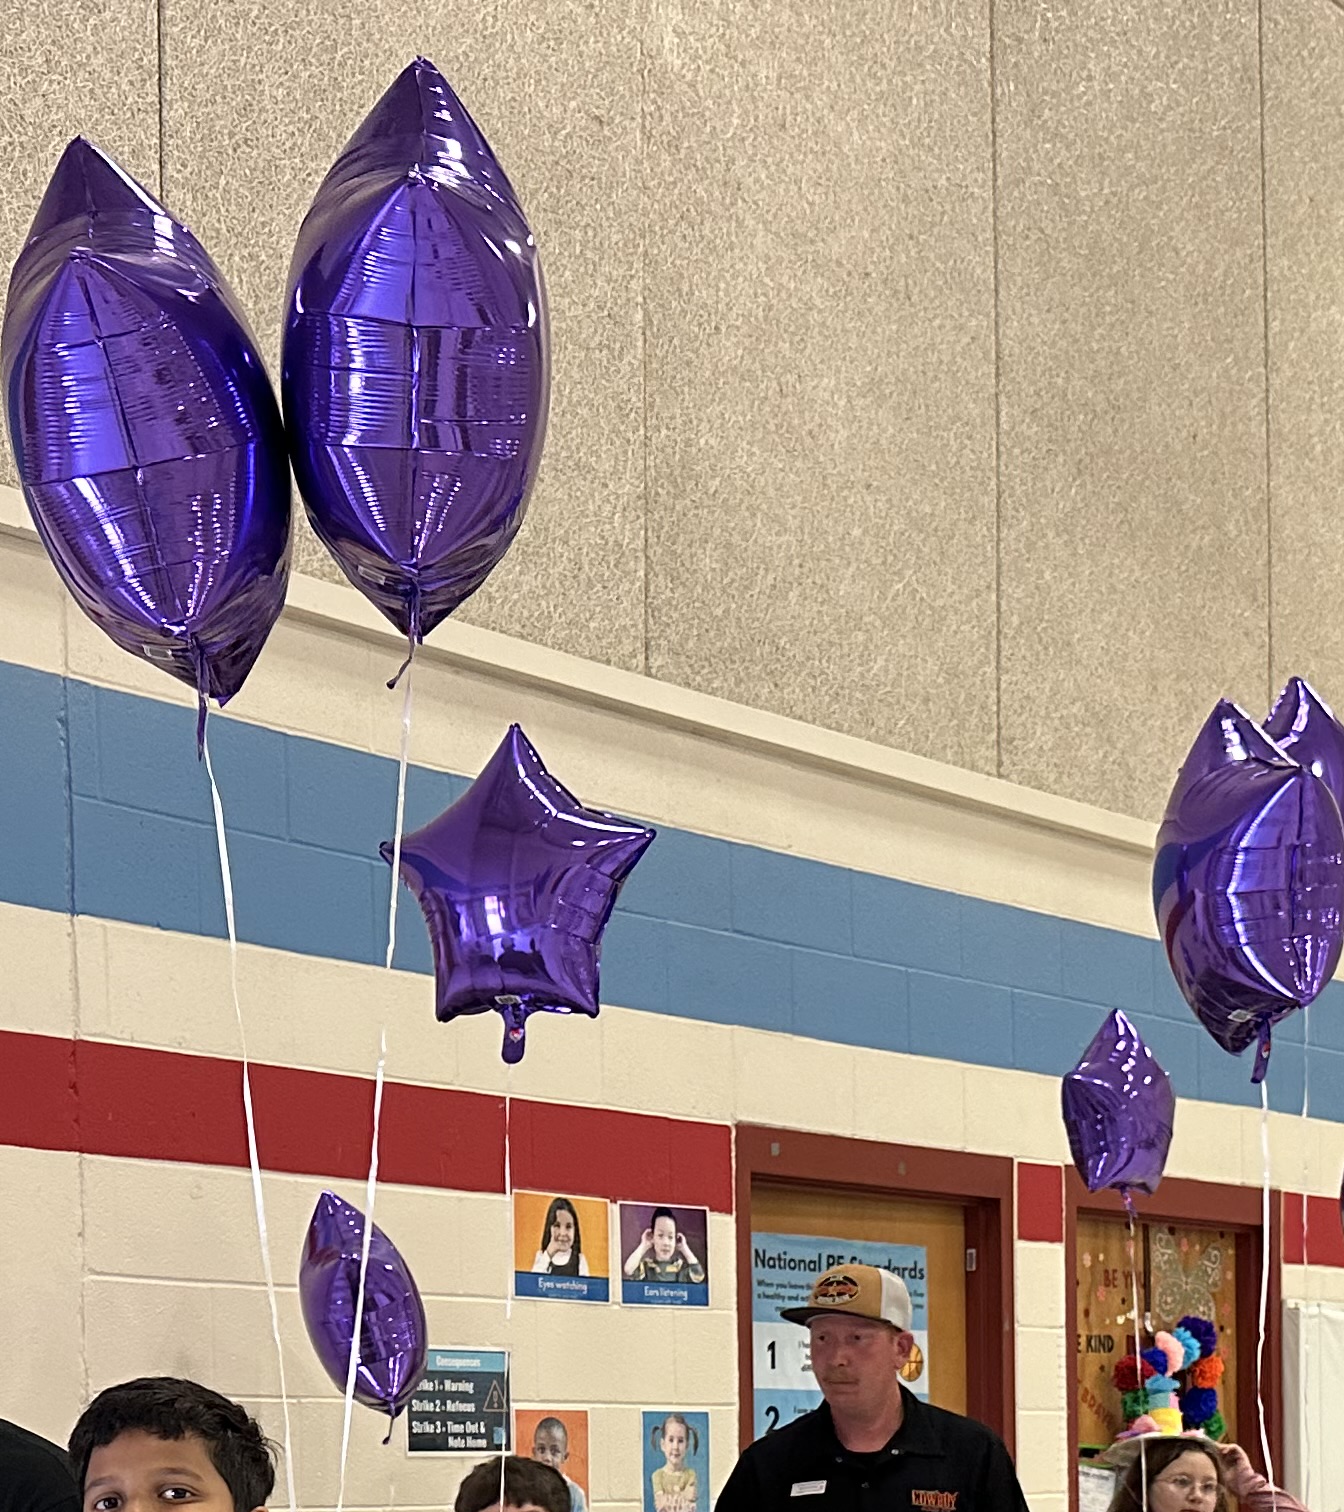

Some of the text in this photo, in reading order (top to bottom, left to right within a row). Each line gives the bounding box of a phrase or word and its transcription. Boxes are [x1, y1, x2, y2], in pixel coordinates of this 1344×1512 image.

[754, 1249, 823, 1273] National
[538, 1277, 588, 1295] Eyes watching
[1104, 1269, 1118, 1288] BE
[644, 1286, 659, 1297] Ears
[1086, 1335, 1114, 1353] KIND
[767, 1341, 776, 1370] 1
[444, 1380, 475, 1394] Warning
[411, 1400, 434, 1412] Strike
[435, 1400, 441, 1412] 2
[446, 1400, 476, 1412] Refocus
[412, 1421, 435, 1434] Strike
[435, 1421, 441, 1434] 3
[446, 1421, 464, 1434] Time
[465, 1421, 479, 1434] Out
[479, 1421, 486, 1434] &
[765, 1406, 780, 1435] 2
[447, 1436, 488, 1448] Note Home
